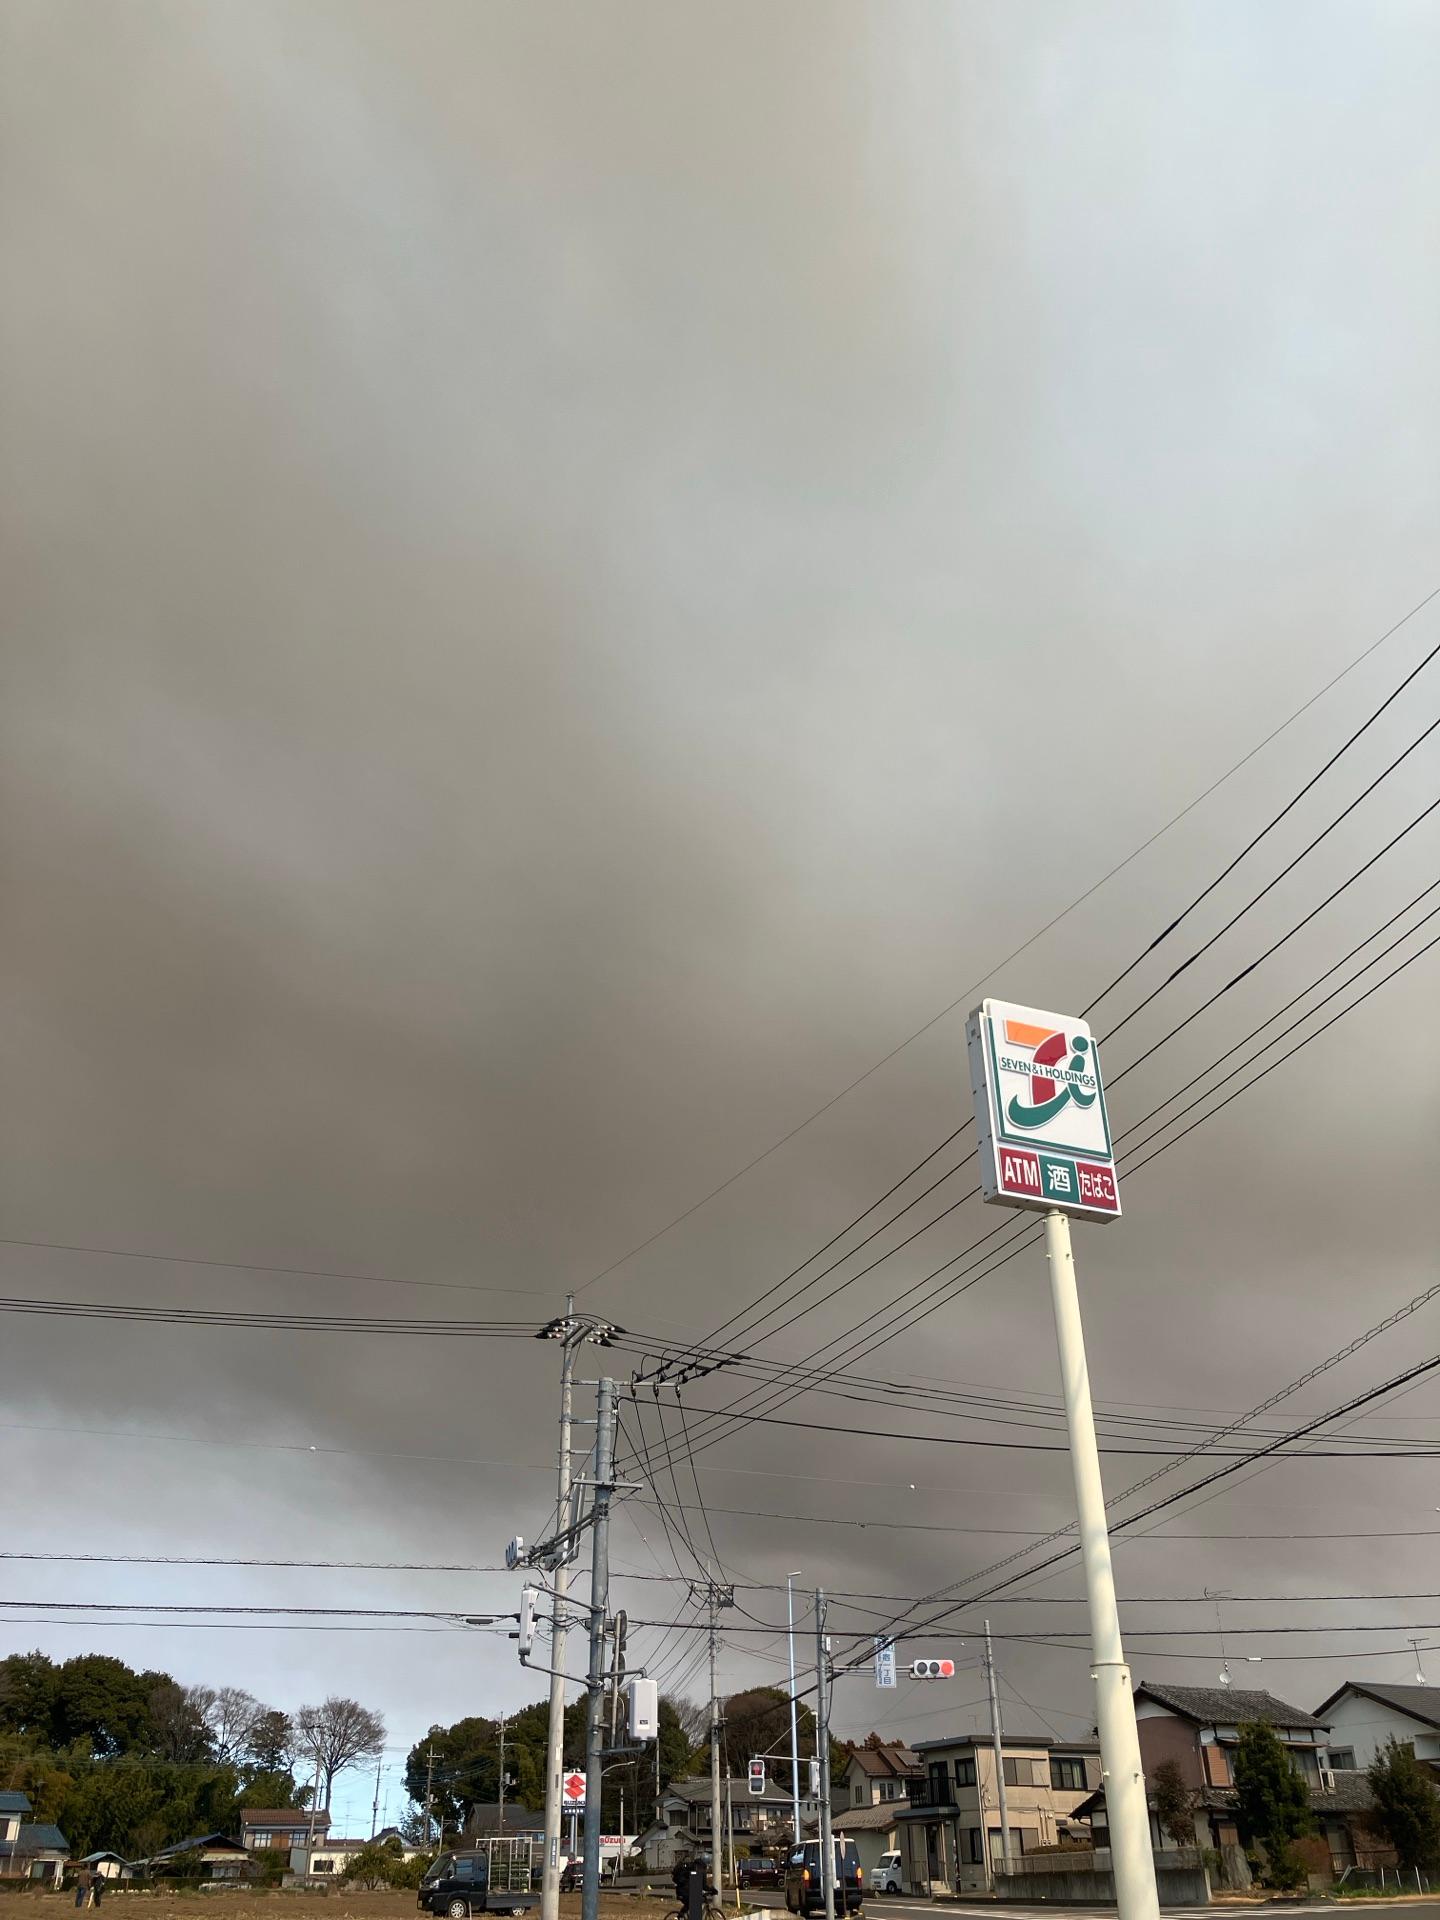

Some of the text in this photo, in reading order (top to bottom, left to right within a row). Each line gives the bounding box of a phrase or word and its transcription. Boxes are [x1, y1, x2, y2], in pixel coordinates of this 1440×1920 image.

[1045, 1066, 1096, 1087] HOLDINGS
[1004, 1155, 1039, 1187] ATM
[1046, 1162, 1071, 1193] 酒
[1079, 1168, 1116, 1201] たばこ
